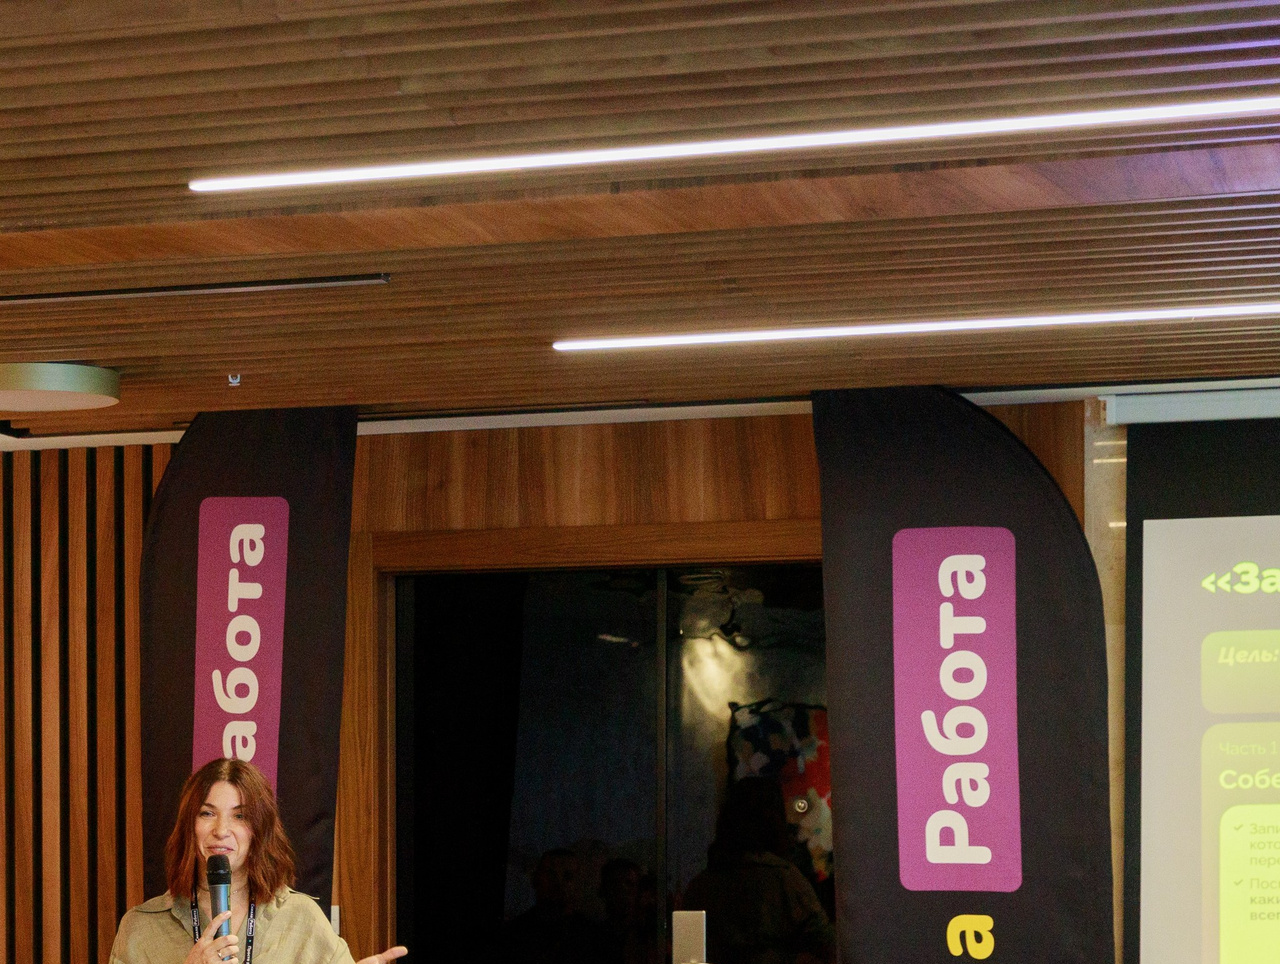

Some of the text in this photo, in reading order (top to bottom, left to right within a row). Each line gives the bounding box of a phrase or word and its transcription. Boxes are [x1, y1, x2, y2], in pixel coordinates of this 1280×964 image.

[211, 523, 266, 763] абота
[1218, 646, 1279, 667] Цель:
[920, 554, 992, 864] Работа
[1249, 878, 1280, 889] Пос
